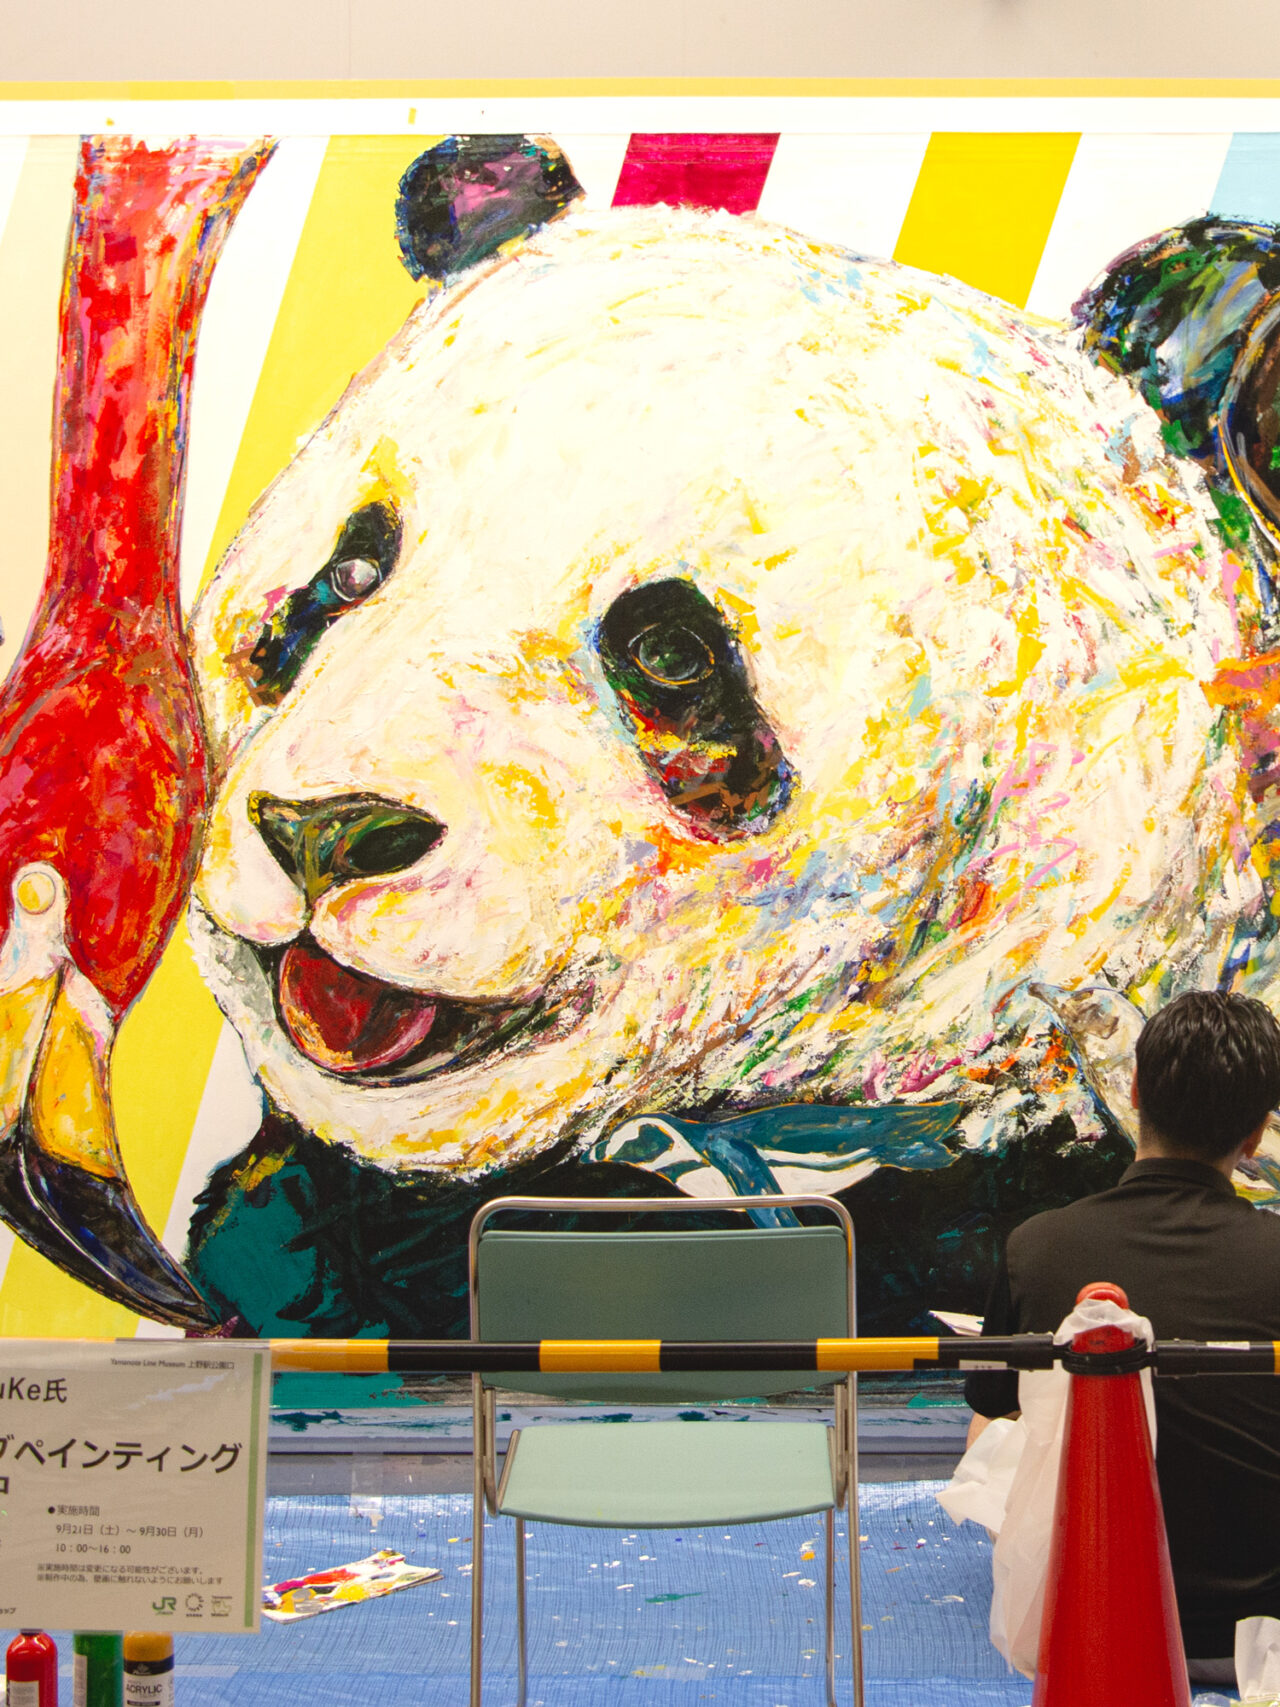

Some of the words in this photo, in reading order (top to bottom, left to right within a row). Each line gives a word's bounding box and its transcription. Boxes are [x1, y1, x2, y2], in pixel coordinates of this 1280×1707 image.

[57, 1504, 100, 1517] 実施時間
[152, 1596, 177, 1610] JR
[126, 1683, 163, 1695] ACRYLIC
